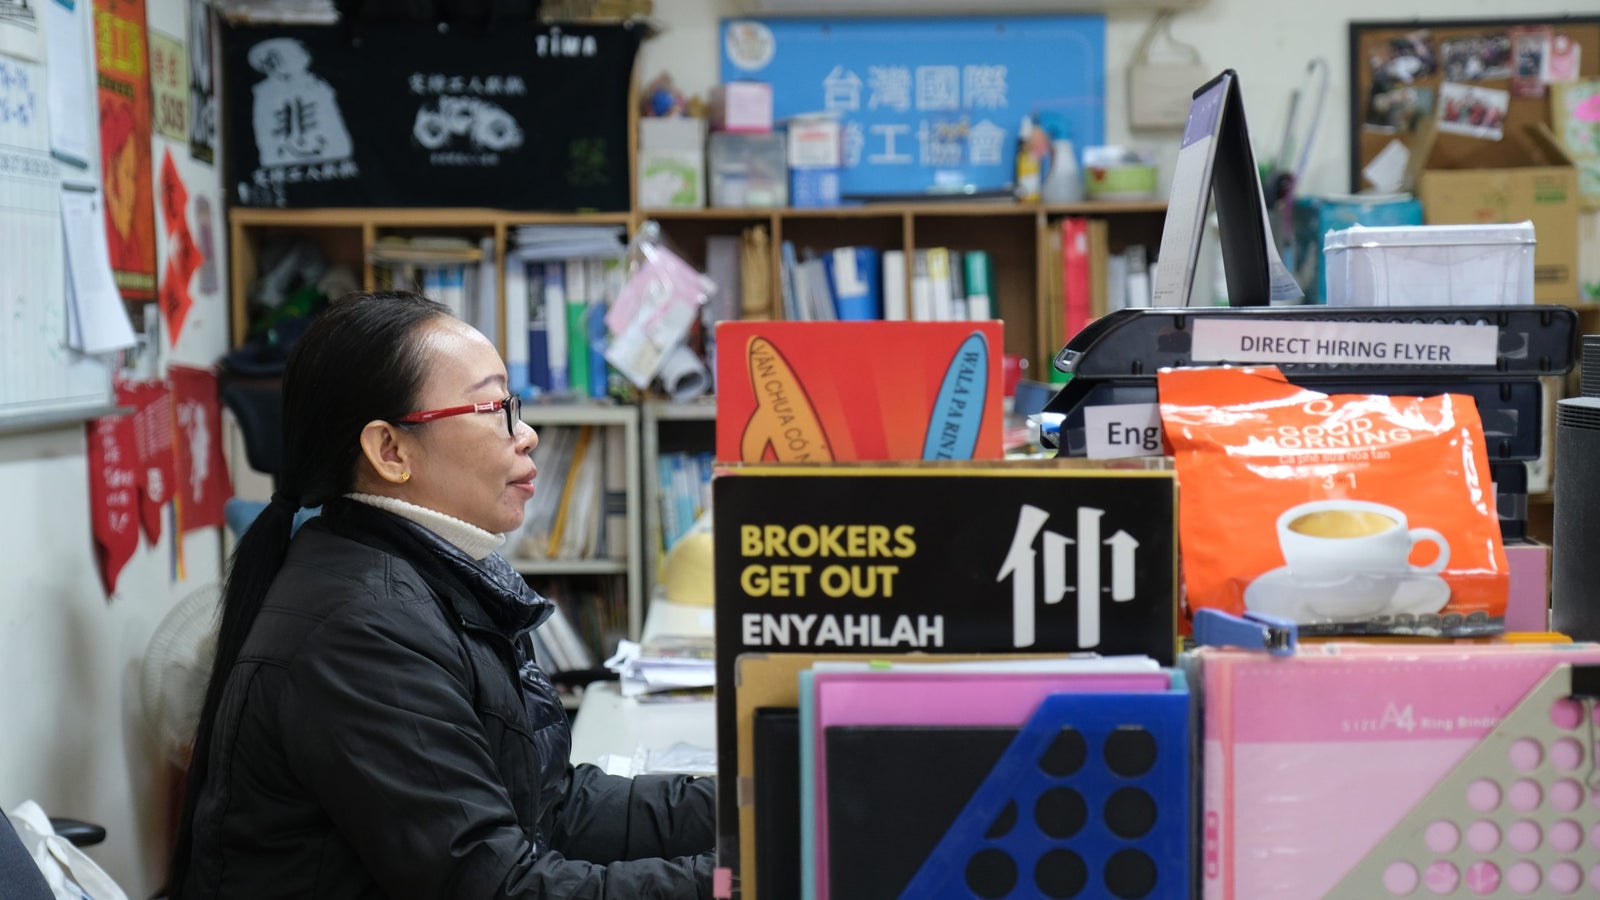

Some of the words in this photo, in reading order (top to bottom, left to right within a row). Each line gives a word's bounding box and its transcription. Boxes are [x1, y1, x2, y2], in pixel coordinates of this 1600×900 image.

[822, 65, 1009, 113] 台灣國際
[1240, 335, 1310, 354] DIRECT
[1316, 339, 1387, 359] HIRING
[1393, 342, 1451, 362] FLYER
[953, 351, 979, 394] WALA
[947, 397, 967, 418] PA
[1277, 418, 1373, 438] GOOD
[1321, 474, 1336, 490] 3
[1345, 472, 1358, 489] 1
[740, 524, 917, 558] BROKERS
[740, 565, 811, 597] GET
[819, 565, 899, 597] OUT
[996, 504, 1140, 649] 仲
[741, 613, 945, 649] ENYAHLAH
[1380, 701, 1416, 733] A4
[1420, 716, 1454, 732] Ring
